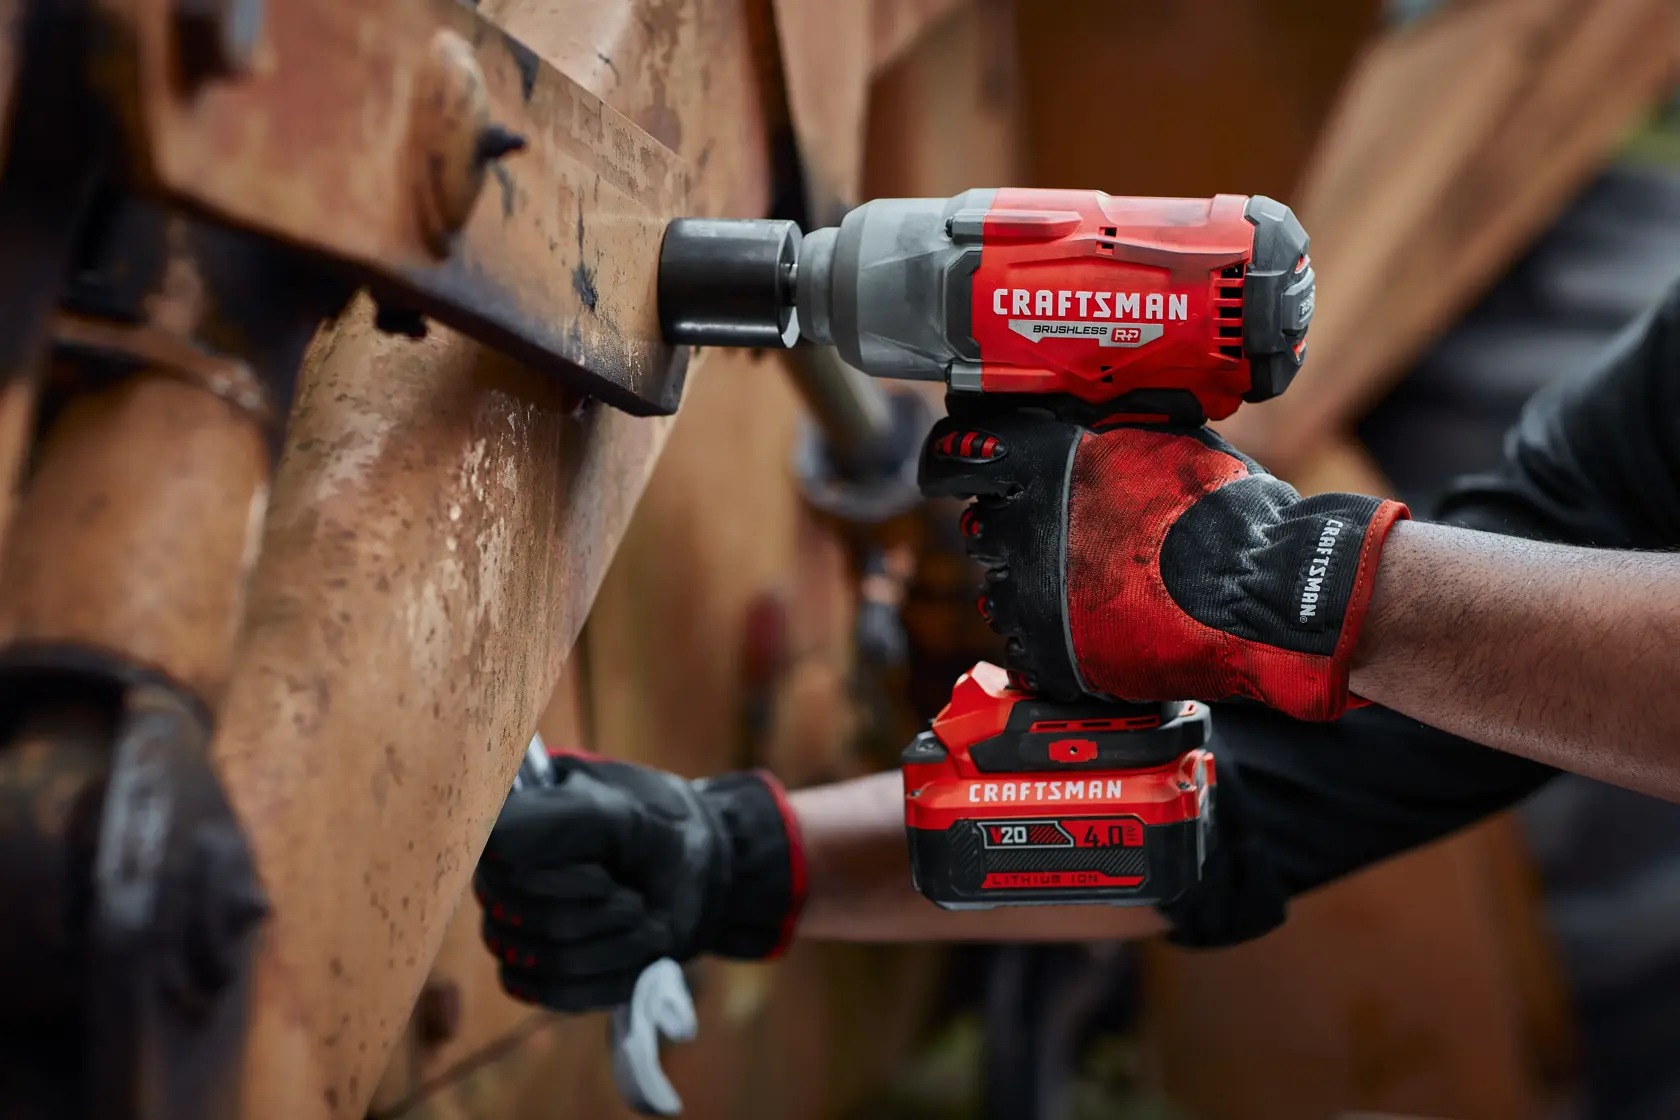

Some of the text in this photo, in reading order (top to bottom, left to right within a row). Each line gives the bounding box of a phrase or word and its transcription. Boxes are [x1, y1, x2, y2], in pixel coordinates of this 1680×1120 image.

[993, 289, 1188, 321] CRAFTSMAN
[1033, 325, 1107, 335] BRUSHLESS
[969, 780, 1122, 802] CRAFTSMAN
[990, 826, 1027, 844] V20
[1084, 826, 1123, 849] 4.0
[992, 874, 1098, 885] LITHIUM ION
